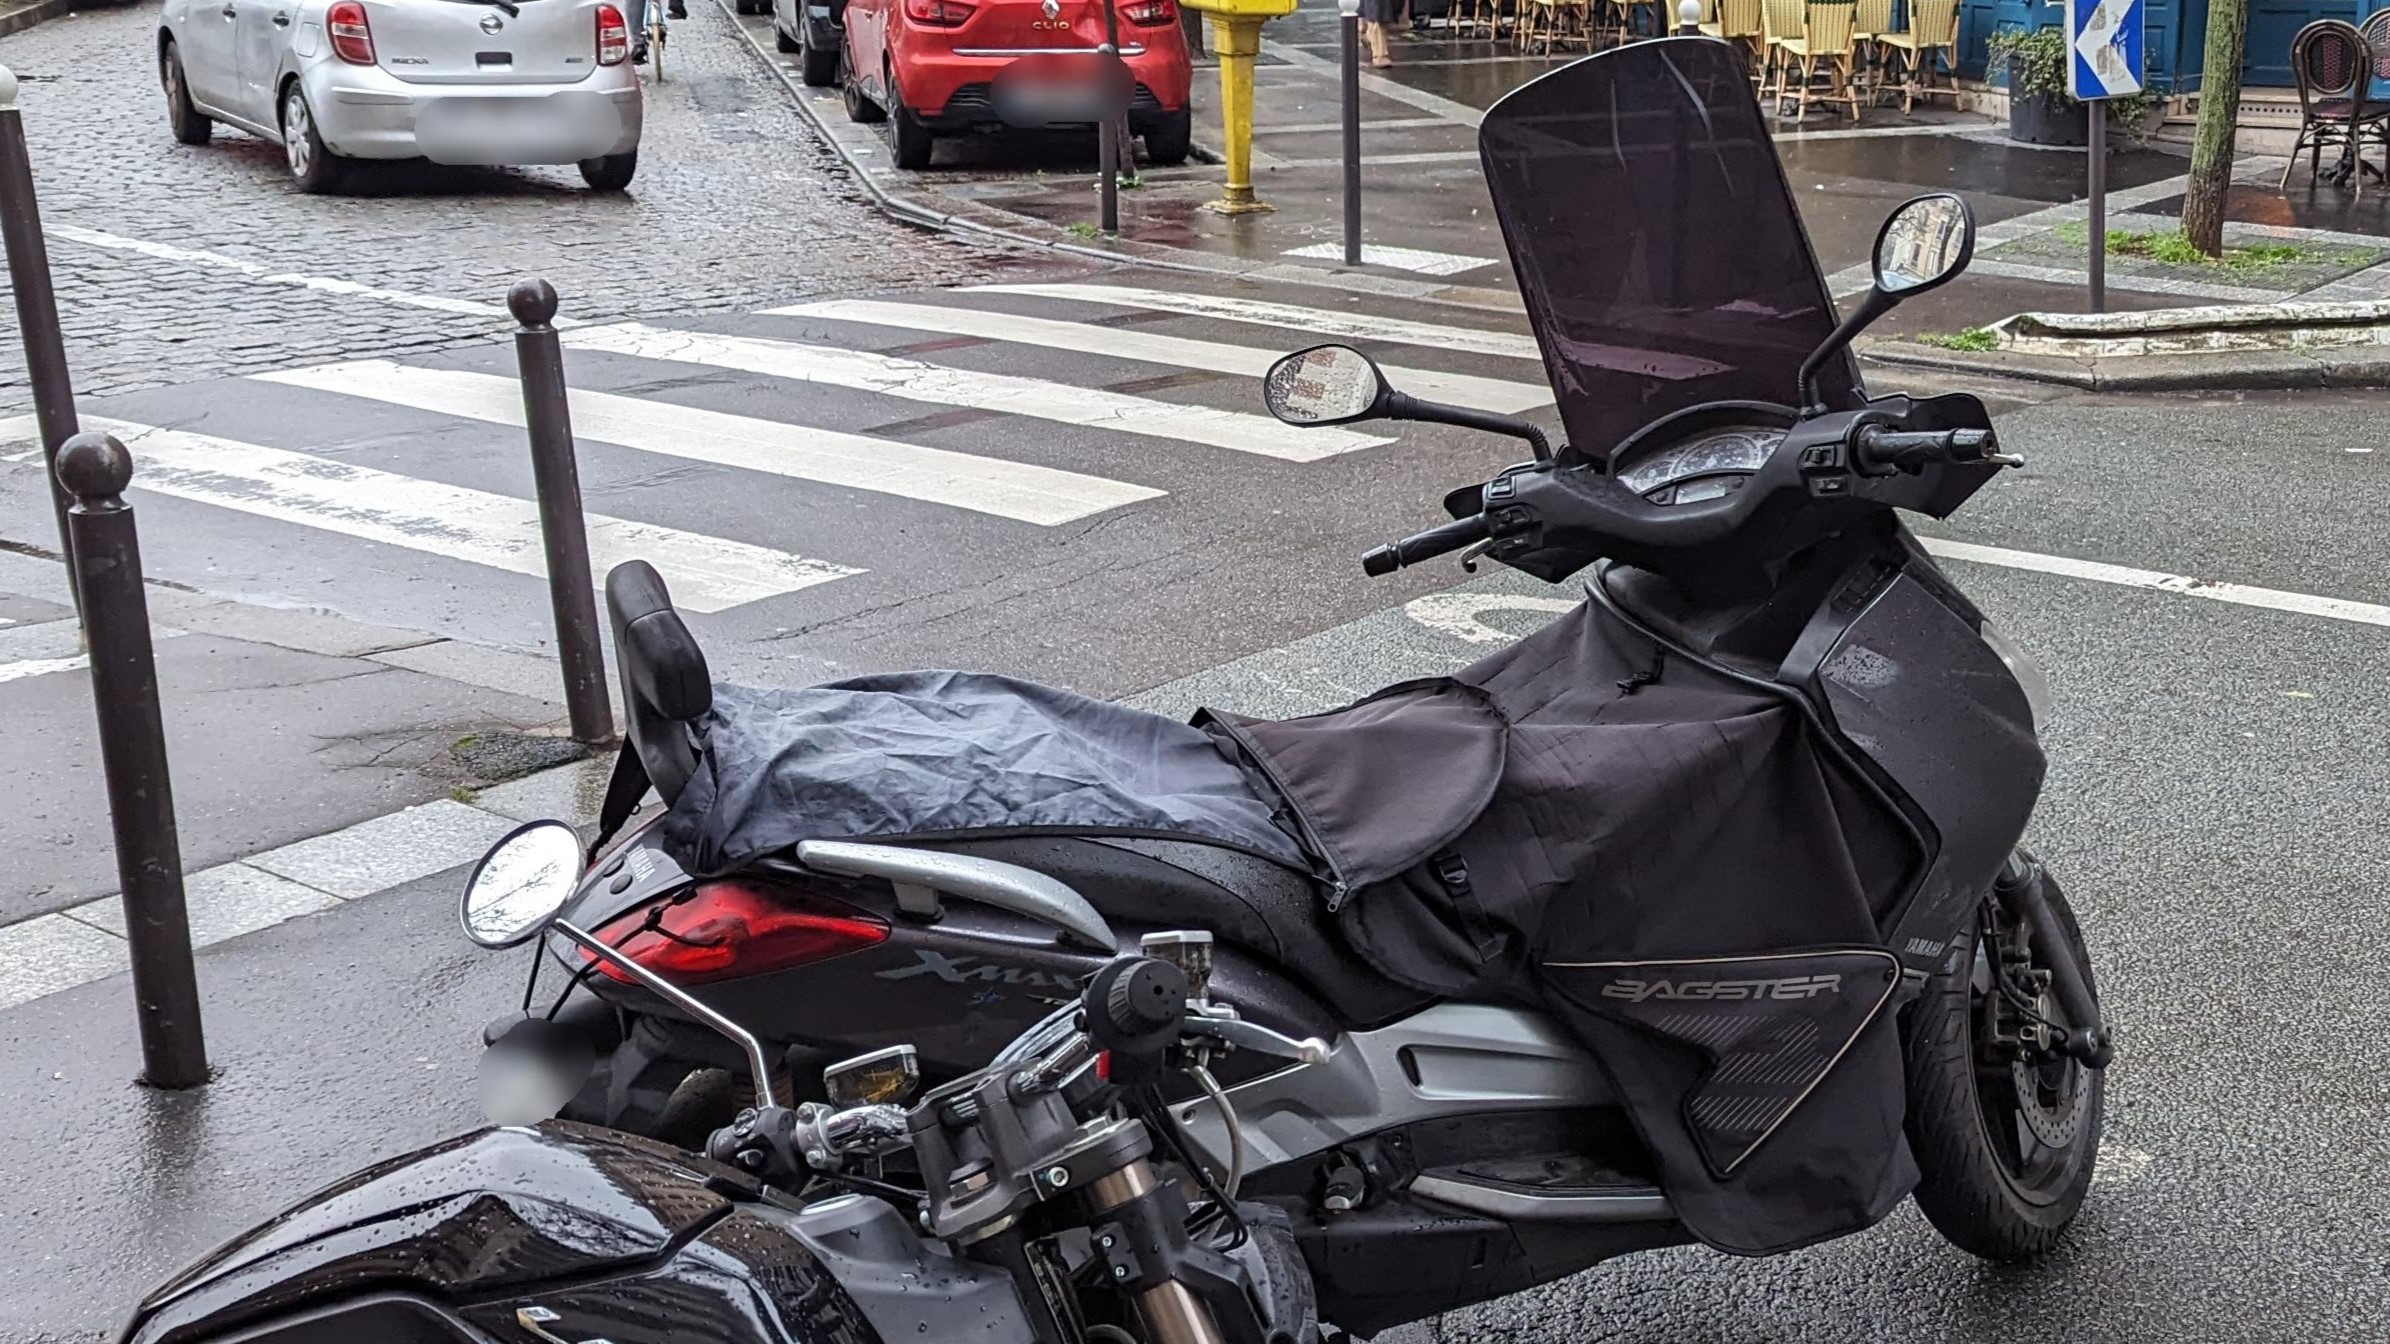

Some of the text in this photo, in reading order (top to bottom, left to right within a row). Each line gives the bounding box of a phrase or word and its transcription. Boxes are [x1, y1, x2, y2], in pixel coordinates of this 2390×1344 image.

[1032, 21, 1070, 30] CLIO
[627, 843, 656, 883] YAMAHA
[1601, 974, 1842, 1003] BAGSTER
